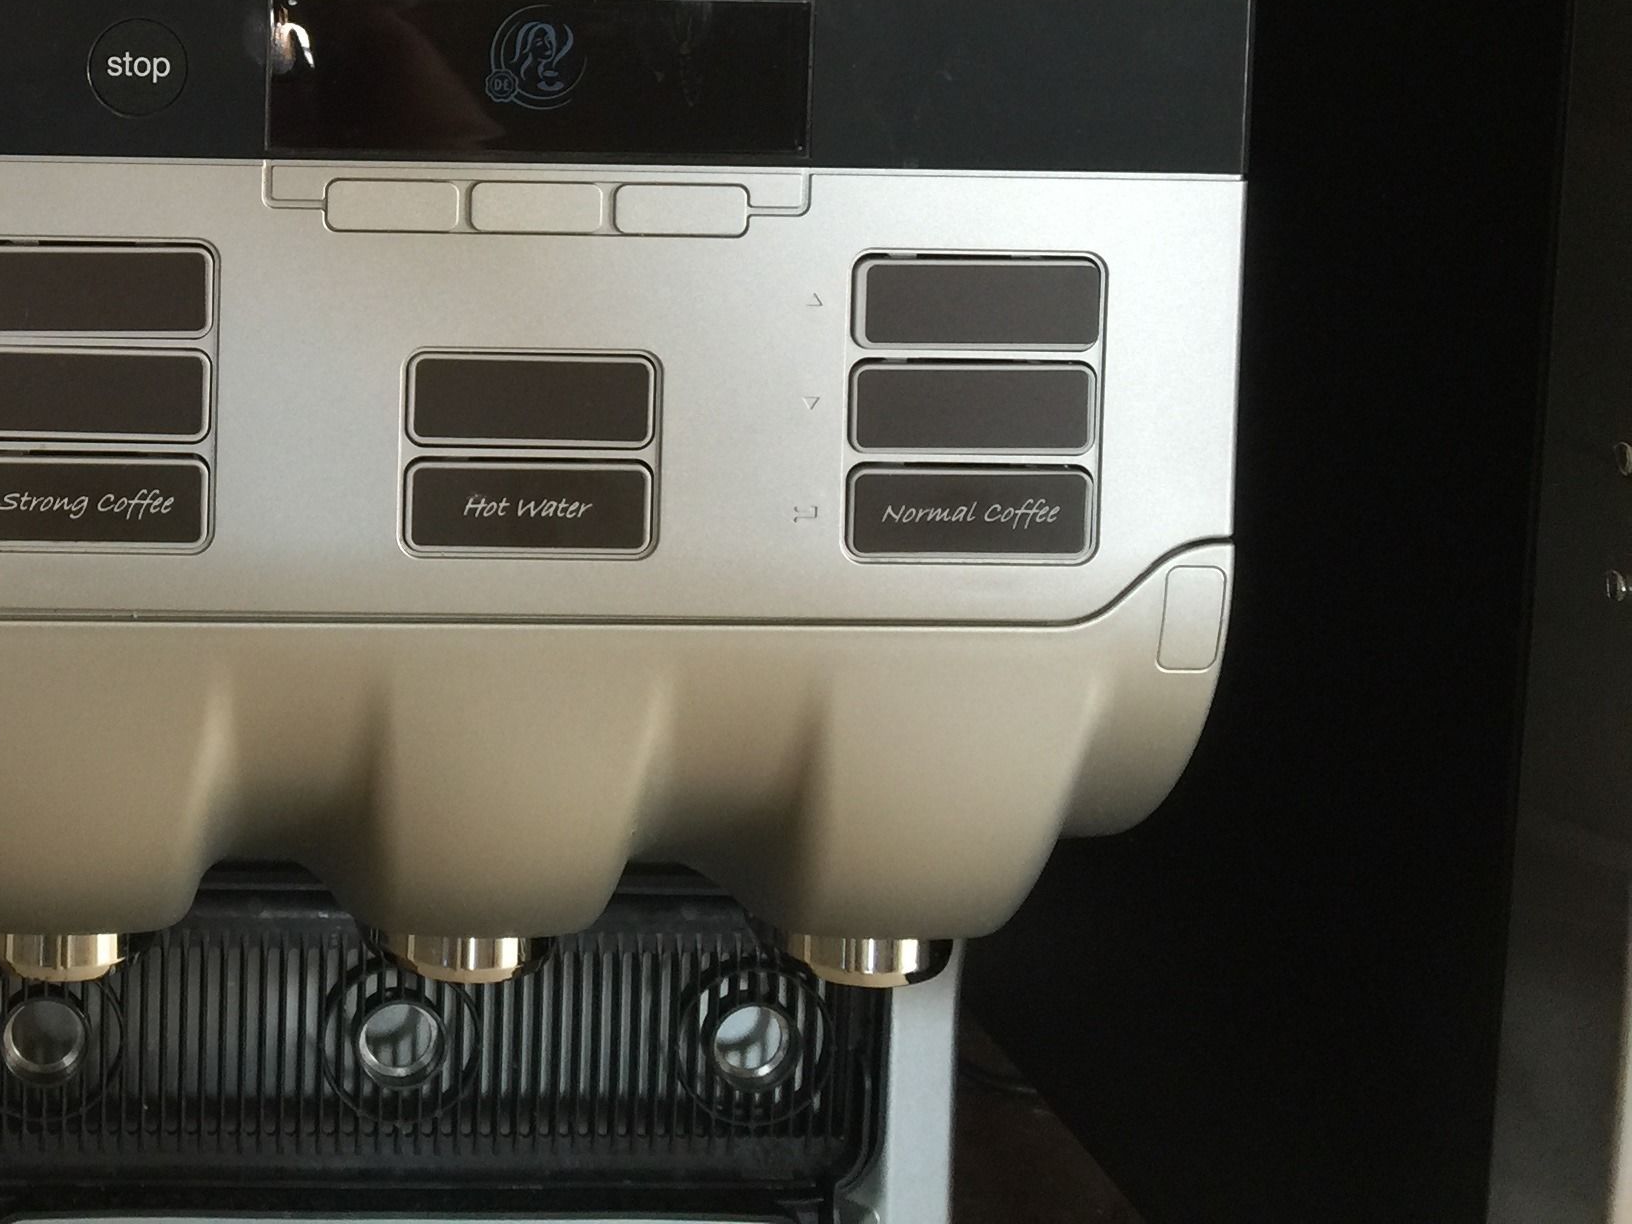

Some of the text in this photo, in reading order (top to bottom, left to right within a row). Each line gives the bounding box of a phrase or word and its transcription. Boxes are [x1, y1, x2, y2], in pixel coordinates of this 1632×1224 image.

[106, 51, 171, 84] stop
[96, 488, 175, 521] Coffee
[463, 496, 593, 519] Hot Water
[881, 498, 1061, 530] Normal Coffee
